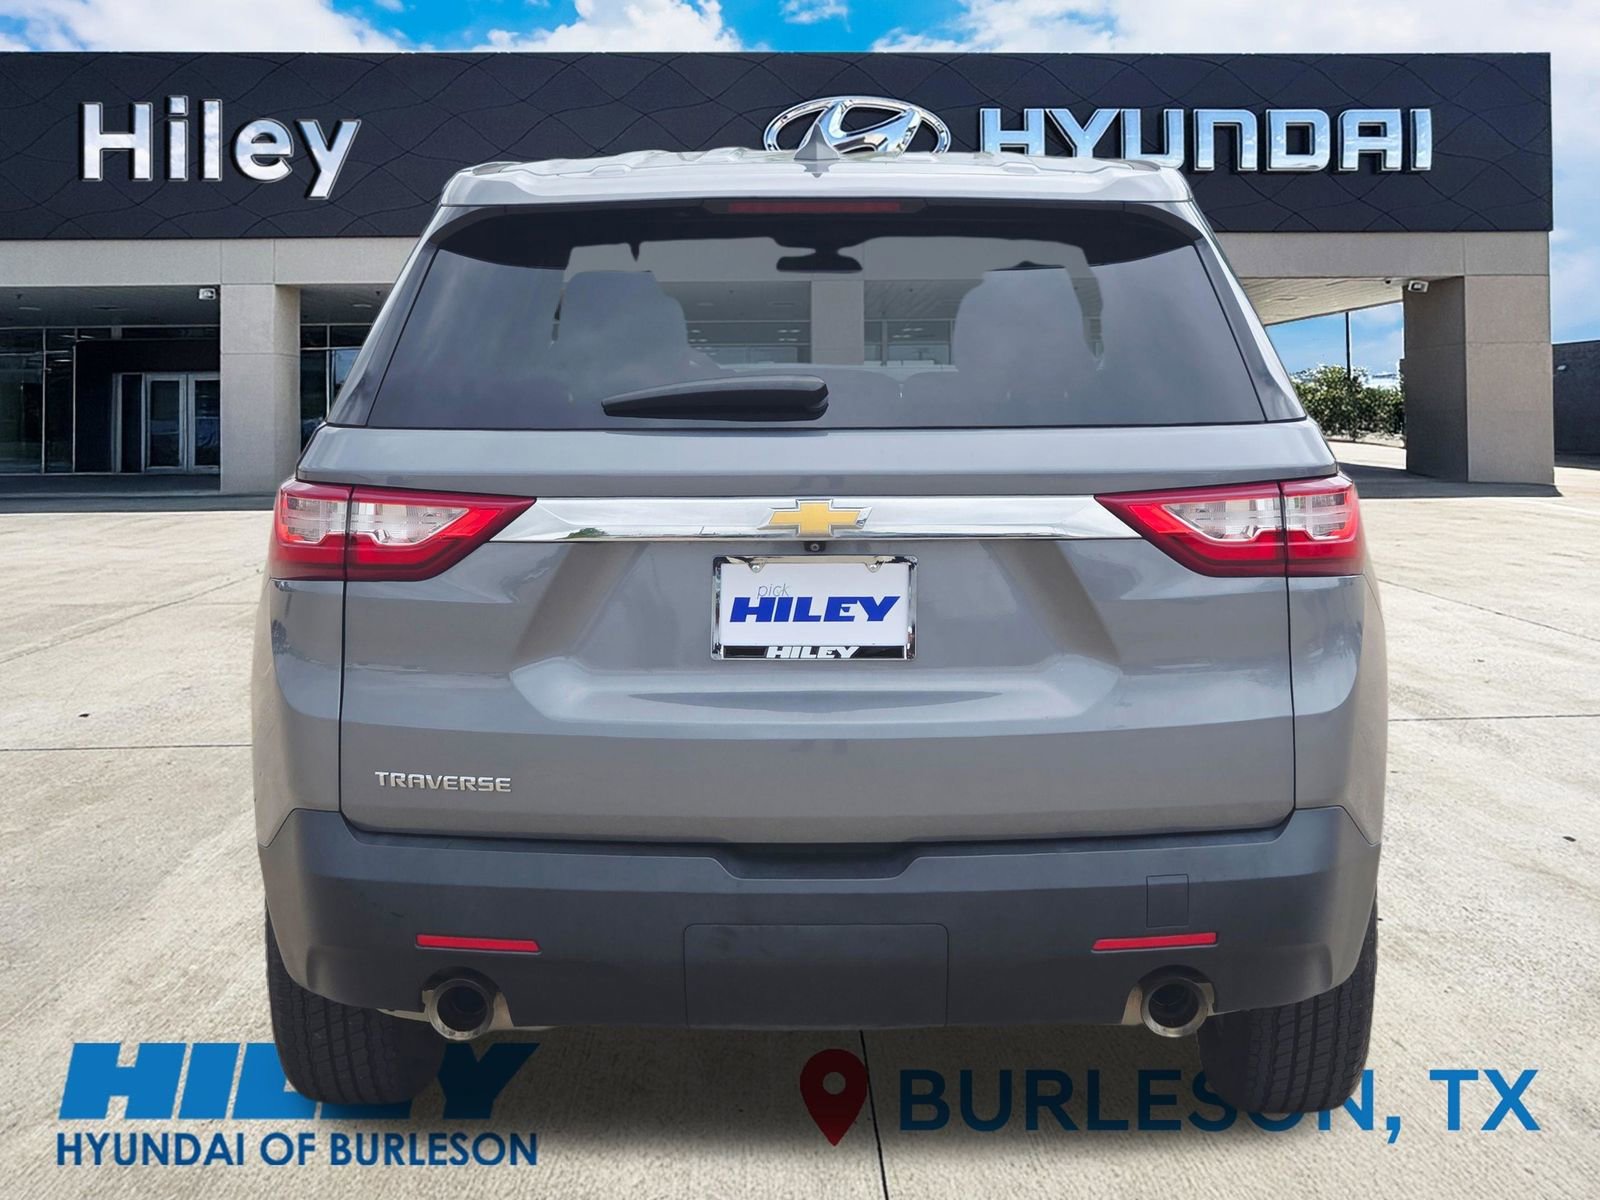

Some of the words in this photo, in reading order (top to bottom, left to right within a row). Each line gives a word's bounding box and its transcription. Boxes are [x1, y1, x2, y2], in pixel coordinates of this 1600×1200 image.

[79, 95, 361, 199] Hiley
[979, 107, 1432, 171] HYUNDAI
[757, 583, 790, 598] pick
[729, 596, 901, 622] HILEY
[766, 646, 859, 659] HILEY
[375, 771, 511, 792] TRAVERSE
